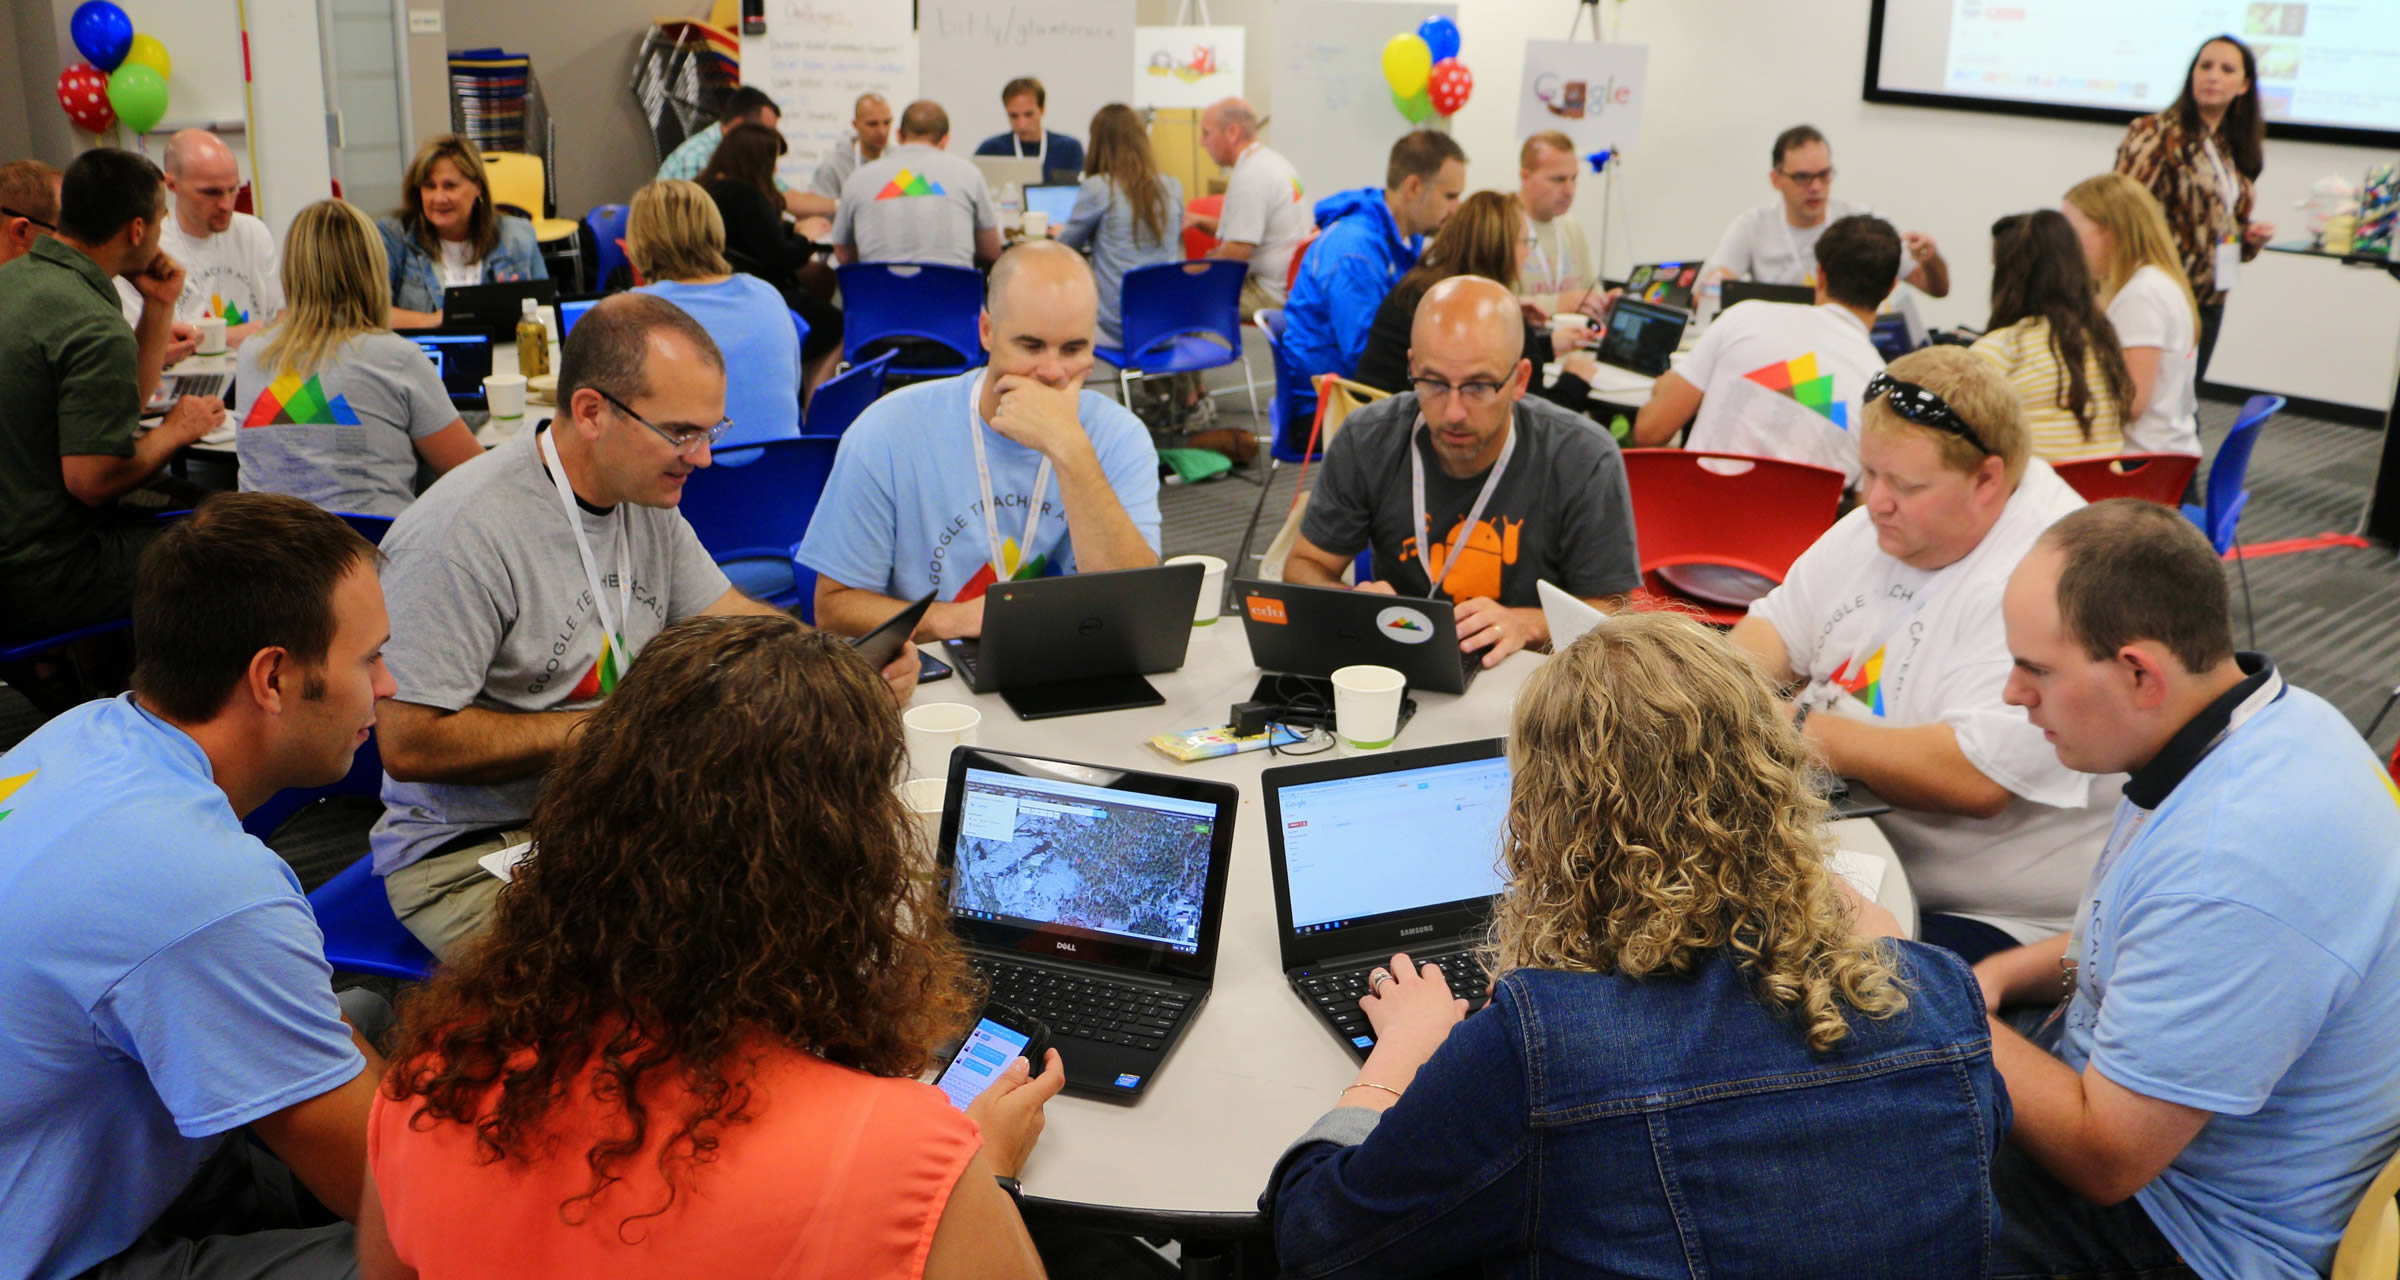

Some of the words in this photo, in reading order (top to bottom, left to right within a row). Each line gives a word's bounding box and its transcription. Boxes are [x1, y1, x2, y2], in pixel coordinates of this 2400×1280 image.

[928, 514, 968, 586] GOOGLE
[969, 494, 1052, 517] TACHR
[1251, 605, 1284, 618] edu
[527, 615, 578, 695] GOOGLE
[1400, 925, 1433, 936] SAMSUNG
[1056, 942, 1076, 951] DELL
